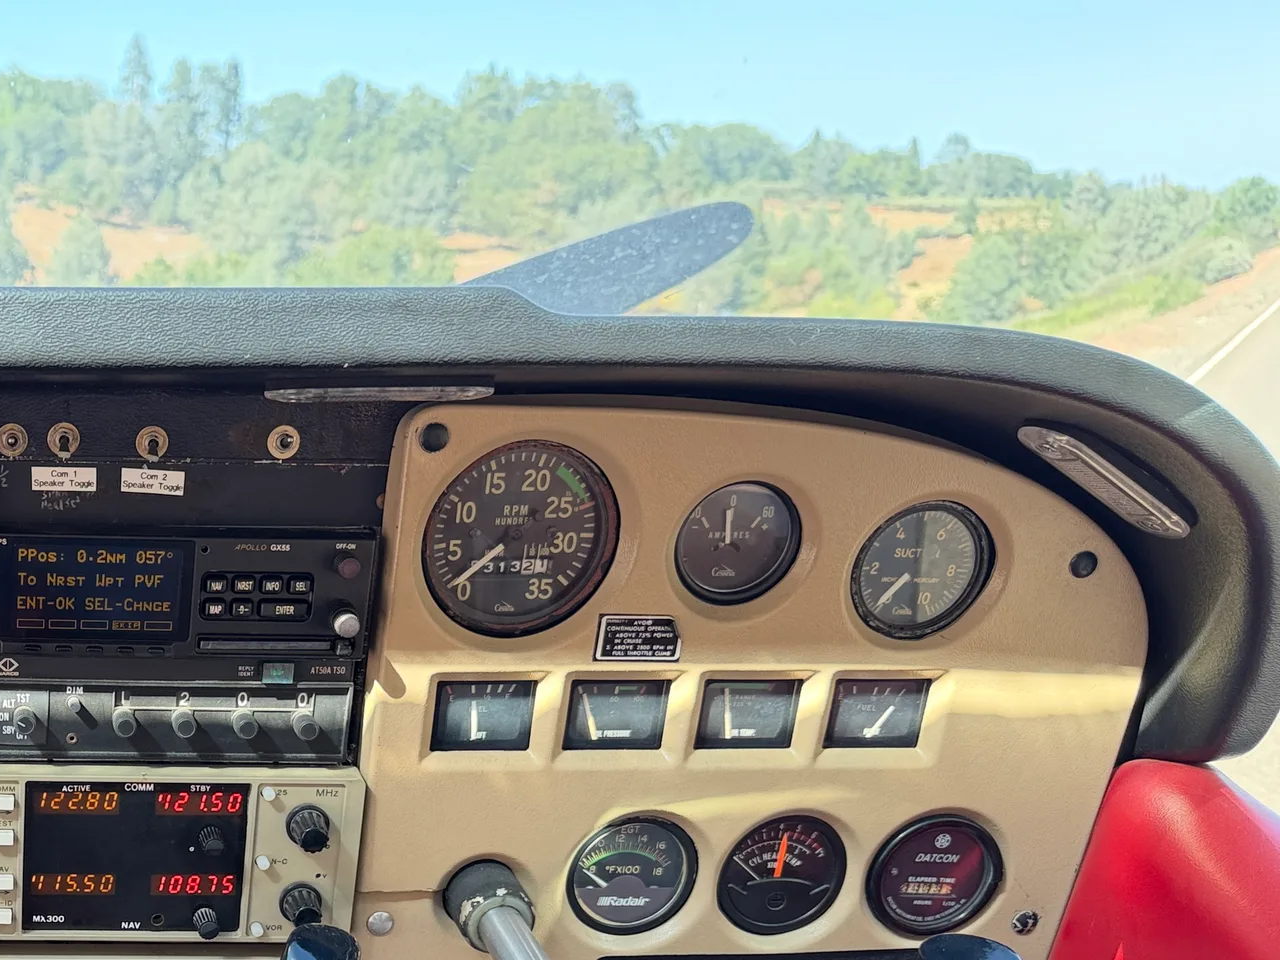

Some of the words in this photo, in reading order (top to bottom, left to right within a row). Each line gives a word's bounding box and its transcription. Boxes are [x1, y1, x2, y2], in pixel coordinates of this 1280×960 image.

[51, 470, 68, 478] Com
[141, 472, 158, 481] Com
[69, 480, 94, 488] Toggle
[485, 472, 506, 495] 15
[521, 470, 551, 492] 20
[123, 481, 154, 489] Speaker
[159, 484, 183, 492] Toggle
[455, 502, 477, 524] 10
[504, 505, 529, 516] RPM
[544, 497, 573, 519] 25
[762, 506, 775, 518] 60
[550, 532, 577, 554] 30
[447, 540, 463, 561] 5
[870, 562, 880, 575] 2
[18, 573, 37, 586] To
[135, 575, 164, 588] PVF
[211, 582, 223, 591] NAV
[237, 582, 253, 590] NRST
[266, 582, 280, 591] INFO
[295, 582, 307, 591] SEL
[525, 578, 554, 600] 35
[17, 596, 75, 610] ENT-OK
[209, 606, 223, 615] MAP
[276, 606, 295, 615] ENTER
[17, 694, 31, 703] TST
[3, 700, 16, 709] ALT
[0, 712, 10, 721] ON
[40, 792, 118, 811] 122.80
[621, 826, 641, 834] EGT
[915, 854, 960, 863] DATCON
[158, 876, 235, 894] 108.75
[607, 896, 651, 906] Radair
